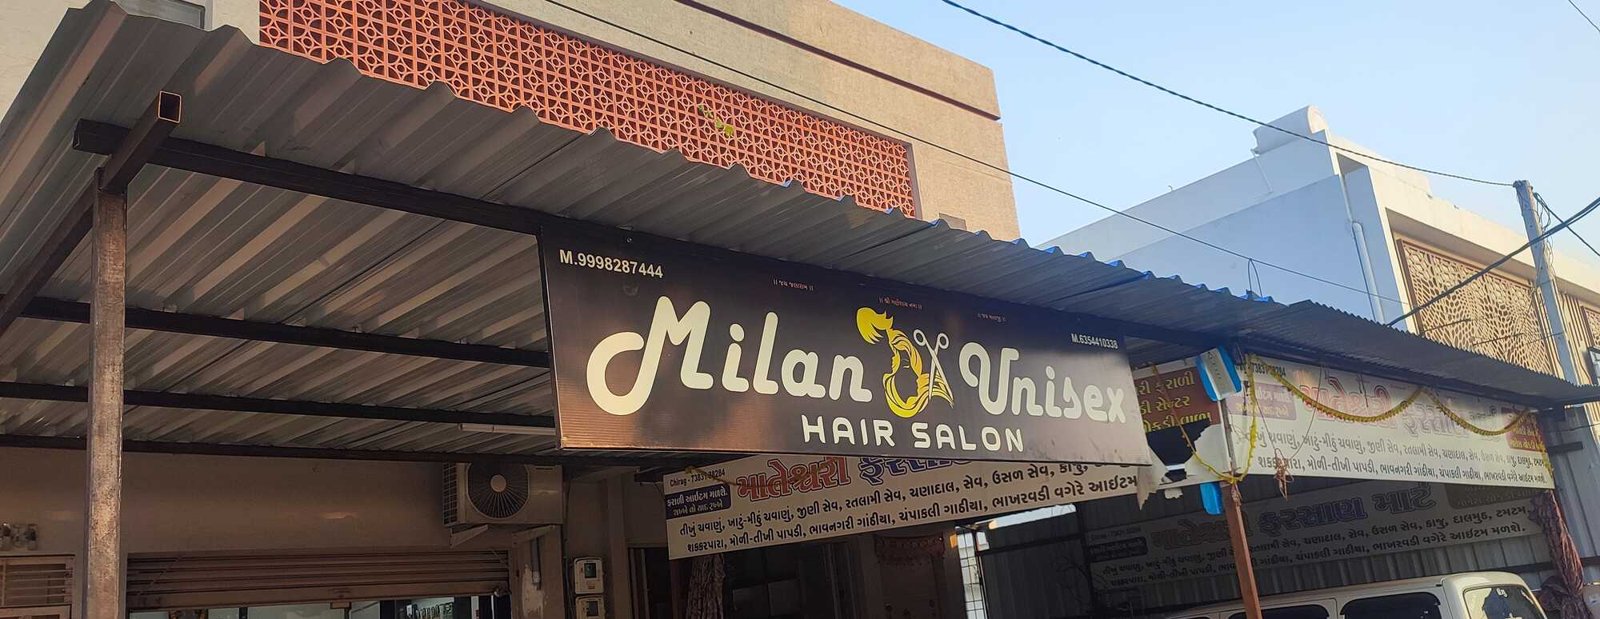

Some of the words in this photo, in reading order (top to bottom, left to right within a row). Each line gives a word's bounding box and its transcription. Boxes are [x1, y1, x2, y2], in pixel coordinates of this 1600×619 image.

[559, 249, 663, 278] M.9998287444
[586, 295, 872, 416] Milan
[959, 342, 1126, 423] Unisex
[801, 414, 895, 447] HAIR
[911, 422, 1024, 452] SALON
[1353, 459, 1378, 475] પાપડી,
[823, 499, 842, 512] સેવ,
[846, 490, 881, 508] રતલામી
[884, 488, 906, 502] સેવ,
[909, 481, 960, 498] ચણાદાલ,
[963, 475, 988, 489] સેવ,
[992, 470, 1024, 484] ઉસળ
[1027, 463, 1054, 477] સેવ,
[776, 523, 806, 539] પાપડી,
[809, 515, 854, 535] ભાવનગરી
[899, 502, 940, 521] ચંપાકલી
[992, 485, 1050, 508] ભાખરવડી
[1054, 480, 1085, 498] વગેરે
[1400, 521, 1422, 531] સેવ,
[1423, 531, 1446, 543] વગેરે
[1491, 522, 1525, 535] મળશે.
